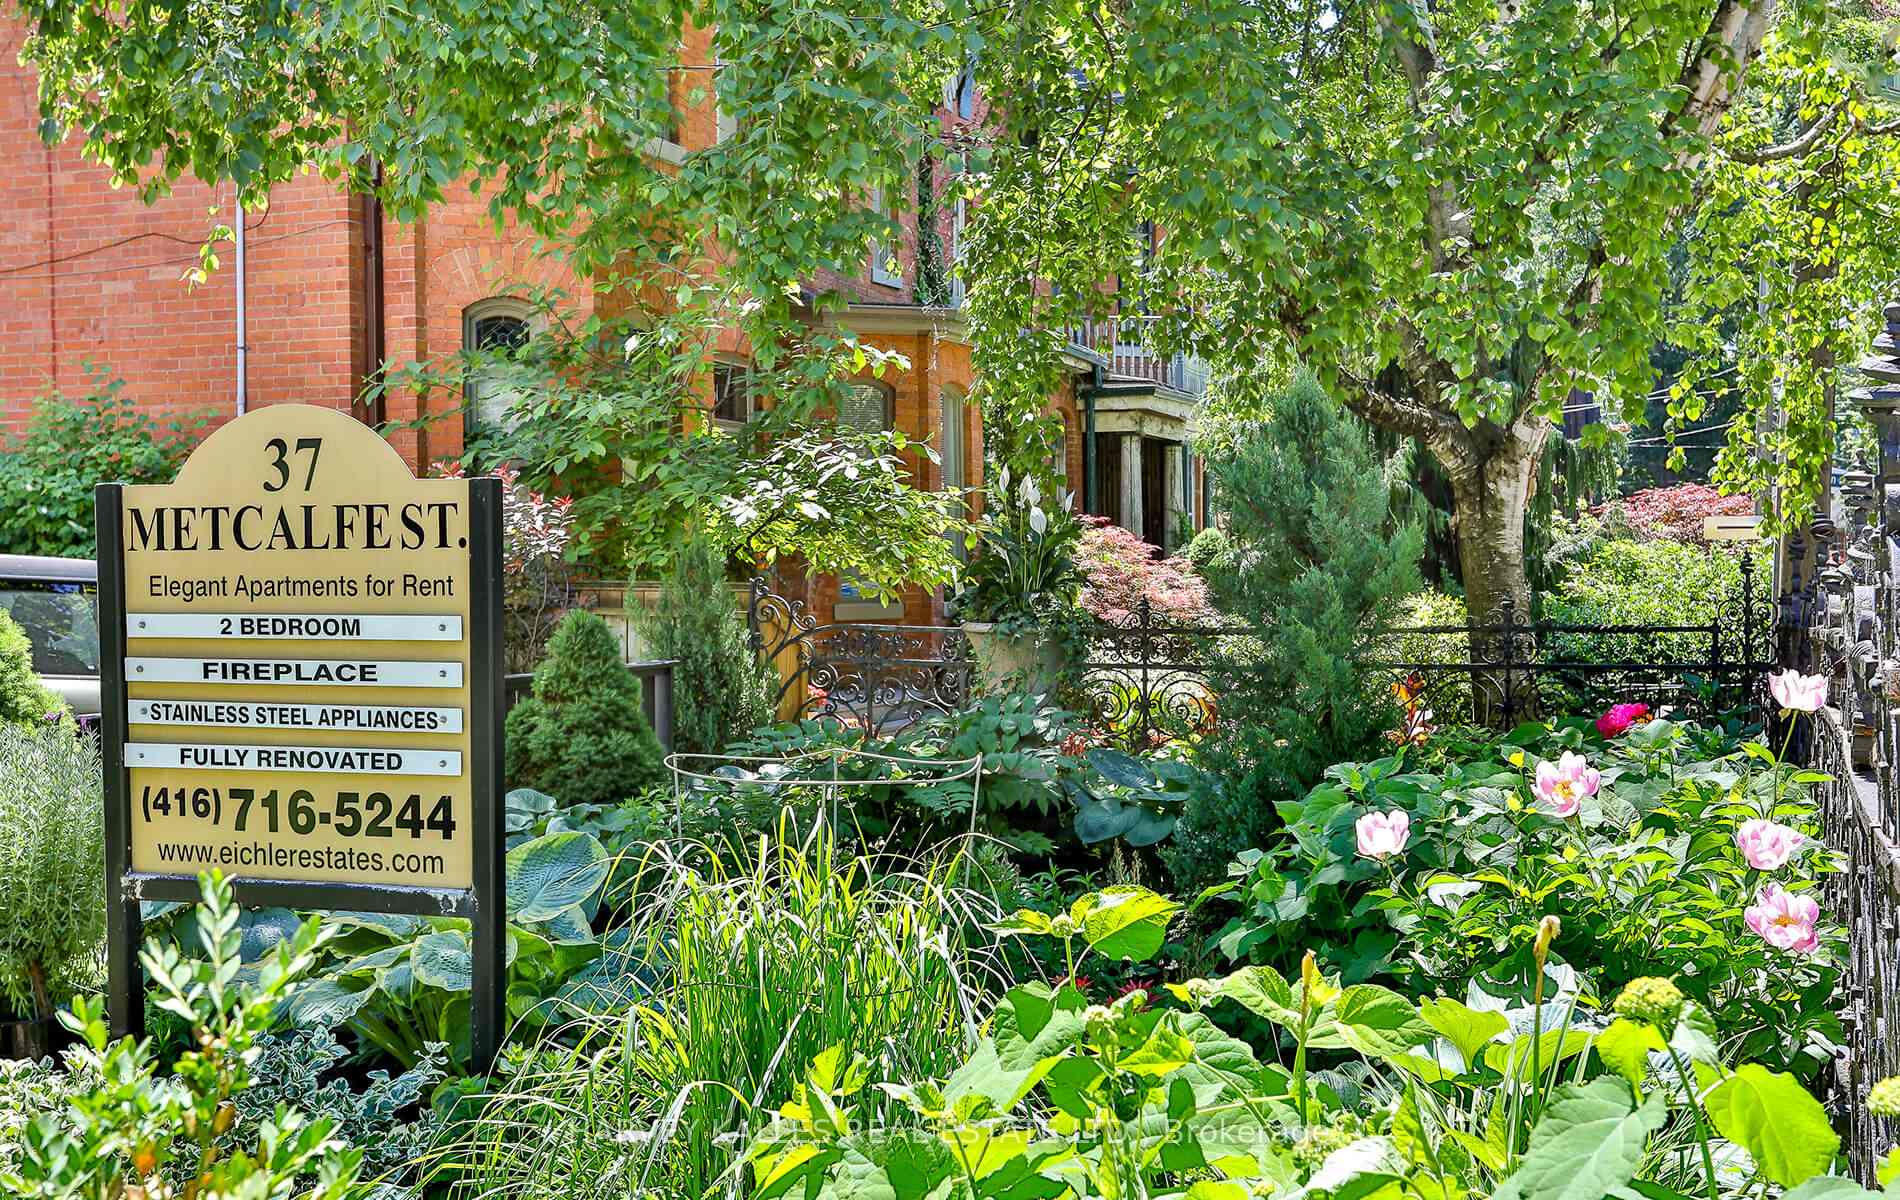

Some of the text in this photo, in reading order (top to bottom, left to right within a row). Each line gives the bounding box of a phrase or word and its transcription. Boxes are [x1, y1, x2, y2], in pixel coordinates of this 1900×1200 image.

[264, 438, 322, 491] 37
[128, 503, 466, 551] METCALFE ST.
[150, 574, 453, 602] Elegant Apartments for Rent
[221, 618, 361, 637] 2 BEDROOM
[202, 663, 379, 682] FIREPLACE
[150, 703, 439, 730] STAINLESS STEEL APPLIANCES
[180, 748, 403, 771] FULLY RENOVATED
[143, 786, 456, 840] (416) 716-5244
[157, 841, 445, 874] www.eichlerestates.com
